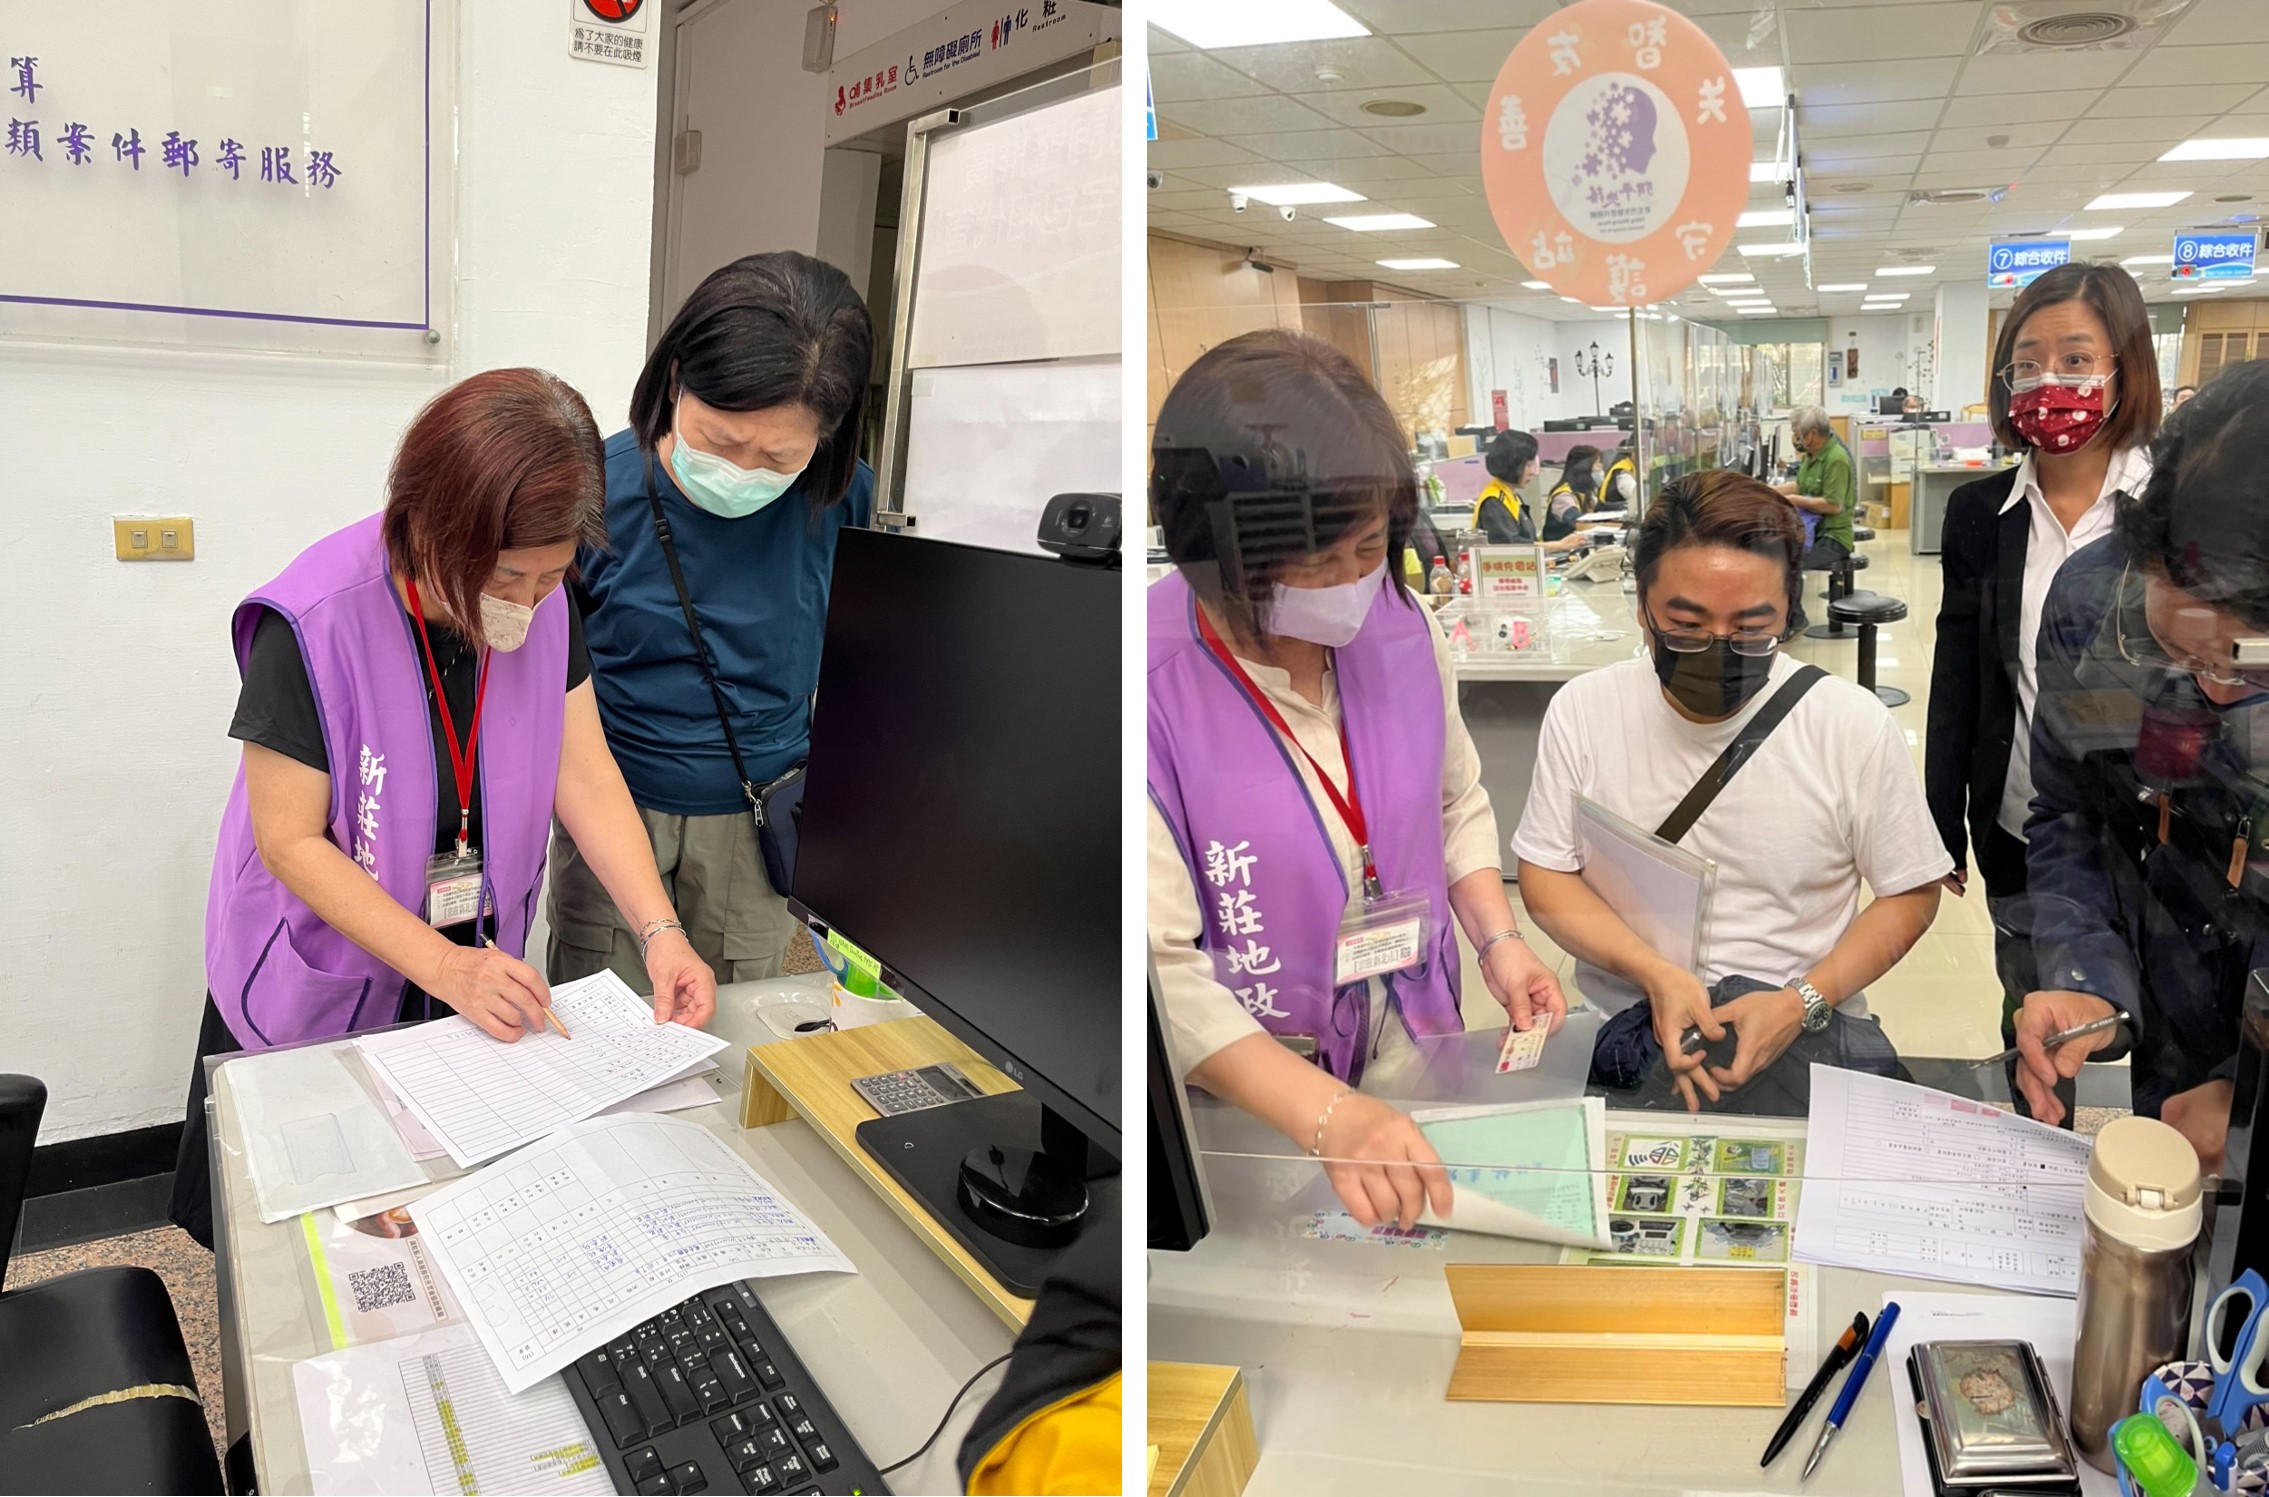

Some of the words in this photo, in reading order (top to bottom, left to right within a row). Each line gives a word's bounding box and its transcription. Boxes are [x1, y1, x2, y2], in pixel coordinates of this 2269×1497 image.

[1032, 14, 1067, 33] Restroom
[574, 40, 642, 62] 請不要在此吸煙
[923, 28, 983, 70] 無障礙廁所
[922, 65, 944, 79] Restroom
[944, 60, 952, 71] for
[952, 56, 961, 67] the
[961, 49, 981, 63] Disabled
[10, 56, 44, 104] 算
[884, 84, 897, 95] Room
[5, 116, 343, 189] 類案件郵寄服務
[2013, 251, 2068, 267] 綜合收件
[2199, 243, 2253, 260] 綜合收件
[354, 743, 387, 881] 新莊地
[1205, 840, 1291, 1019] 新莊地政
[1013, 1067, 1024, 1081] LG
[619, 1394, 627, 1405] Ctrl
[774, 1429, 785, 1445] Home
[747, 1442, 757, 1455] End
